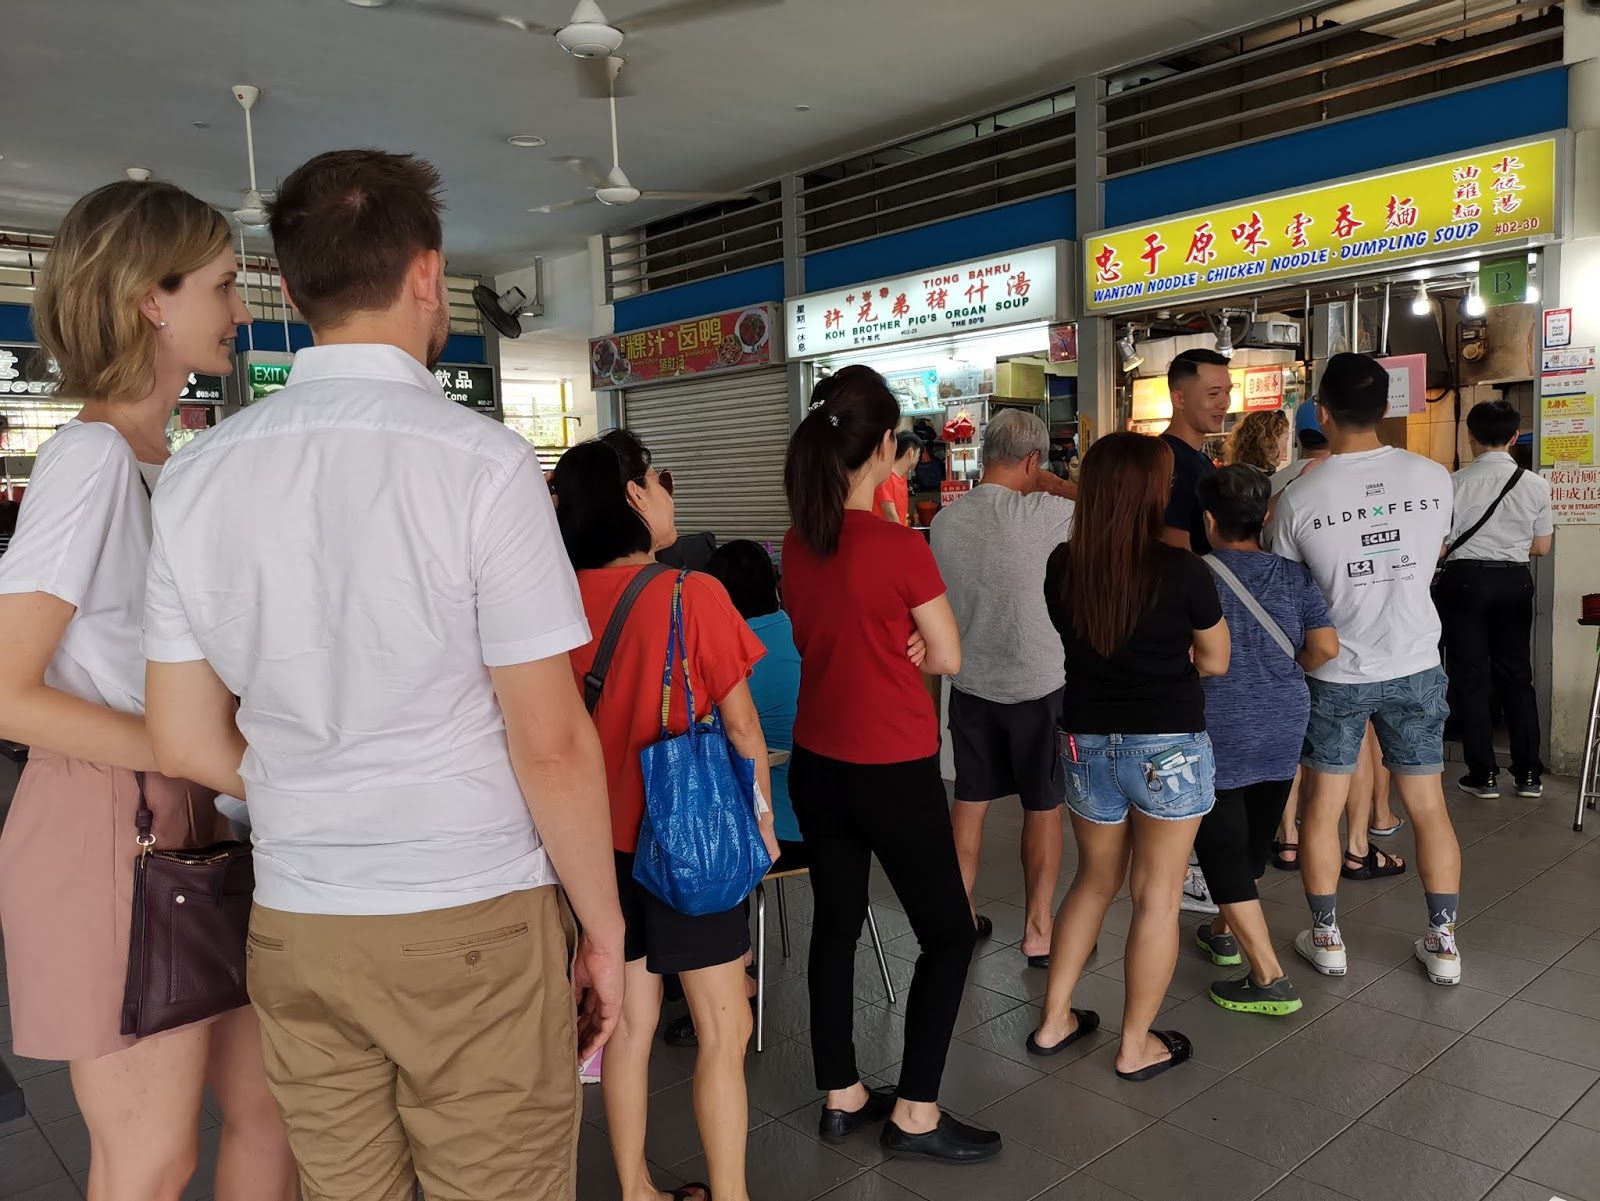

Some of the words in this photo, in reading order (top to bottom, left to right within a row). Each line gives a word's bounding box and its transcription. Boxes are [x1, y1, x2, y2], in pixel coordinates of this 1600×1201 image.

[1494, 217, 1538, 235] #02-30
[1093, 283, 1143, 302] WANTON
[1147, 273, 1197, 293] NOODLE
[1207, 260, 1266, 283] CHICKEN
[1270, 249, 1329, 273] NOODLE
[1340, 231, 1427, 260] DUMPLING
[1433, 222, 1479, 244] SOUP
[923, 273, 960, 289] TIONG
[968, 263, 1011, 280] BAHRU
[1494, 271, 1512, 294] B
[796, 304, 806, 352] 星期一休息
[825, 329, 846, 340] KOH
[852, 319, 901, 336] BROTHER
[908, 313, 937, 326] PIG'S
[945, 305, 987, 319] ORGAN
[995, 297, 1030, 311] SOUP
[951, 319, 966, 327] THE
[254, 367, 281, 381] EXIT
[435, 370, 473, 389] 飲品
[445, 391, 468, 401] Cane
[1369, 531, 1398, 544] CLIF
